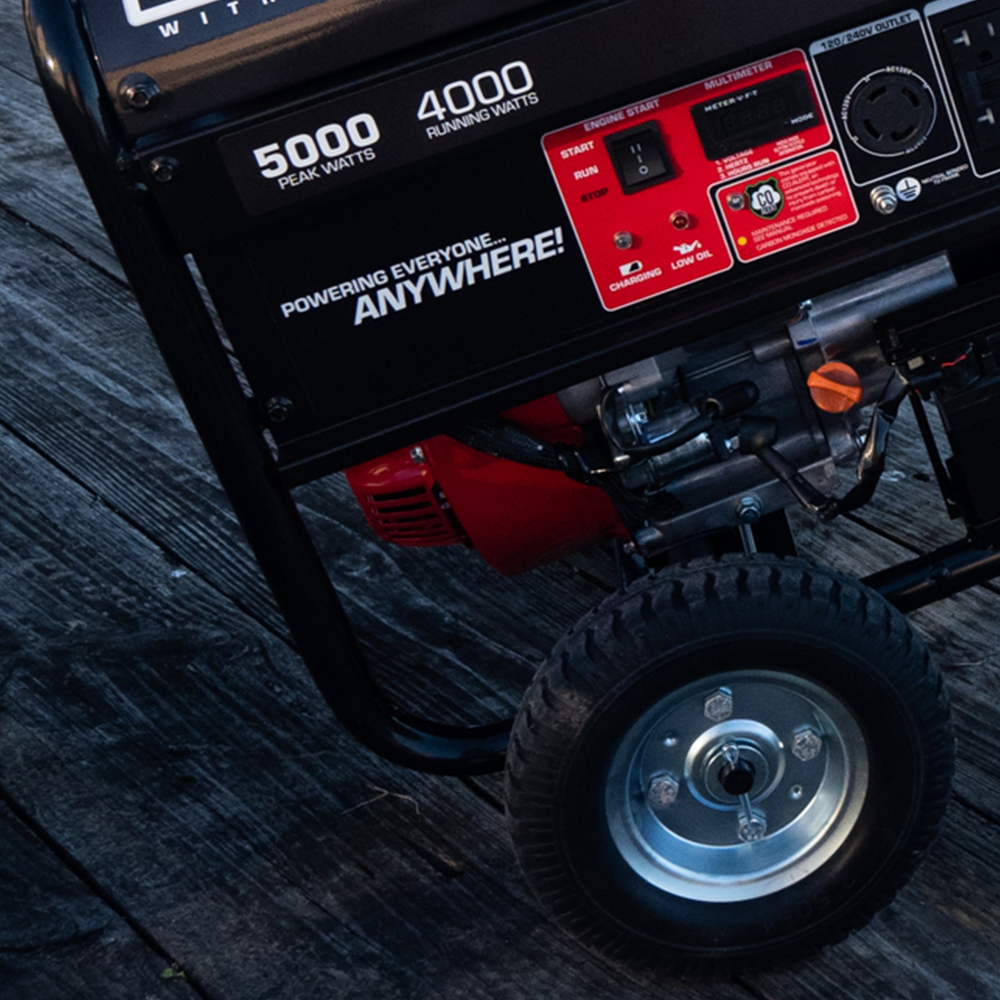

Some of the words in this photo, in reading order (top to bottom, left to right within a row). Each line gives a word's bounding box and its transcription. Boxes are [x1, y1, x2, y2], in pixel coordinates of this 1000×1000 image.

[820, 26, 873, 50] 120/240V
[875, 13, 912, 32] OUTLET
[416, 60, 534, 121] 4000
[704, 61, 773, 91] MULTIMETER
[426, 108, 490, 139] RUNNING
[491, 91, 539, 118] WATTS
[583, 112, 625, 132] ENGINE
[626, 98, 660, 118] START
[253, 113, 380, 178] 5000
[560, 140, 595, 160] START
[278, 167, 320, 190] PEAK
[321, 148, 376, 176] WATTS
[573, 165, 599, 180] RUN
[579, 187, 609, 203] STOP
[756, 189, 774, 207] CO
[750, 216, 796, 237] MAINTENANCE
[796, 204, 828, 220] REQUIRED
[755, 236, 782, 250] CARBON
[782, 224, 815, 241] MONOXIDE
[816, 213, 848, 229] DETECTED
[280, 269, 389, 318] POWERING
[390, 233, 506, 279] EVERYONE...
[354, 226, 565, 326] ANYWHERE!
[670, 255, 696, 270] LOW
[695, 249, 712, 261] OIL
[608, 266, 662, 292] CHARGING
